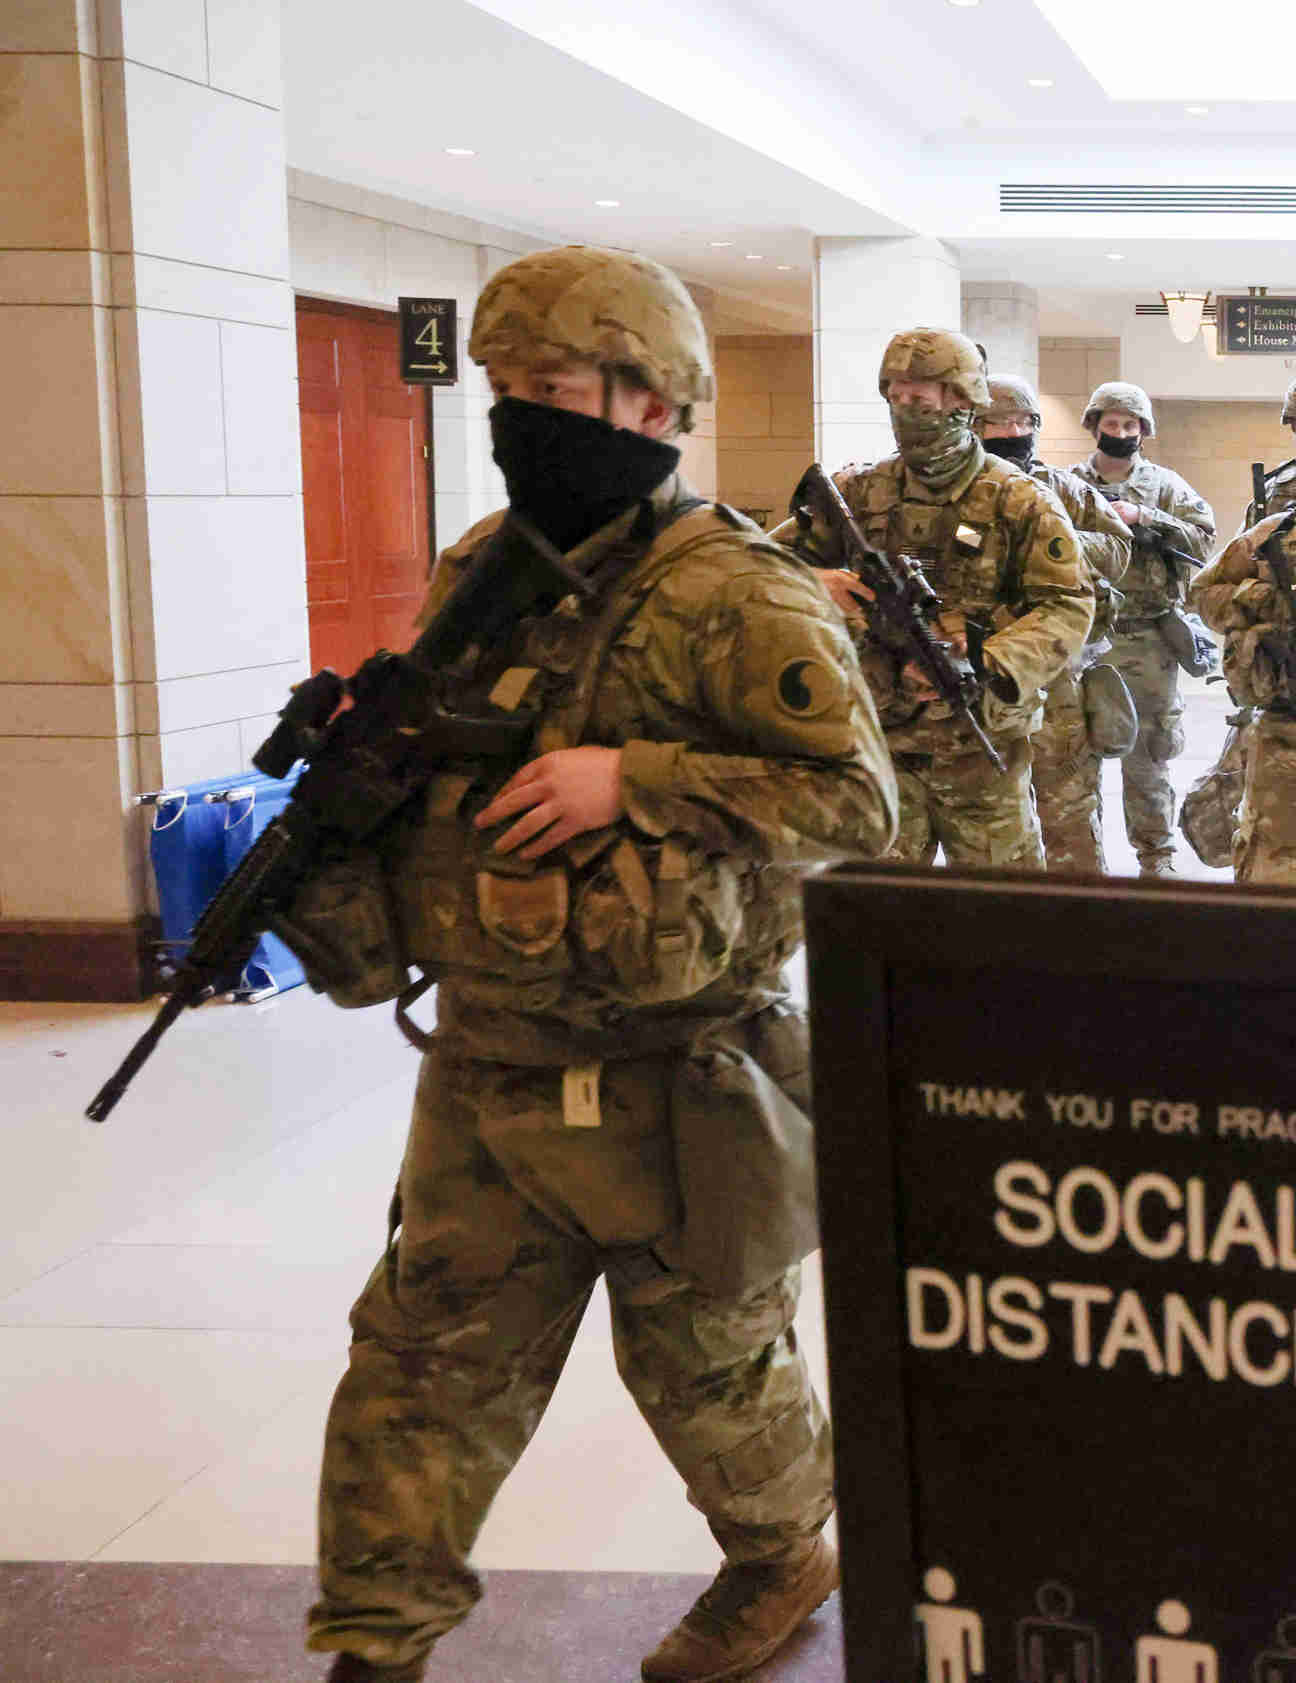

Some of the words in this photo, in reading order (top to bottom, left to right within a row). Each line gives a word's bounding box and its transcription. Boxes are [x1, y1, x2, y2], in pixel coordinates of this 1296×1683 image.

[415, 318, 443, 356] 4
[1254, 335, 1289, 346] House
[920, 1083, 1026, 1120] THANK
[1046, 1094, 1114, 1130] YOU
[1131, 1098, 1199, 1135] FOR
